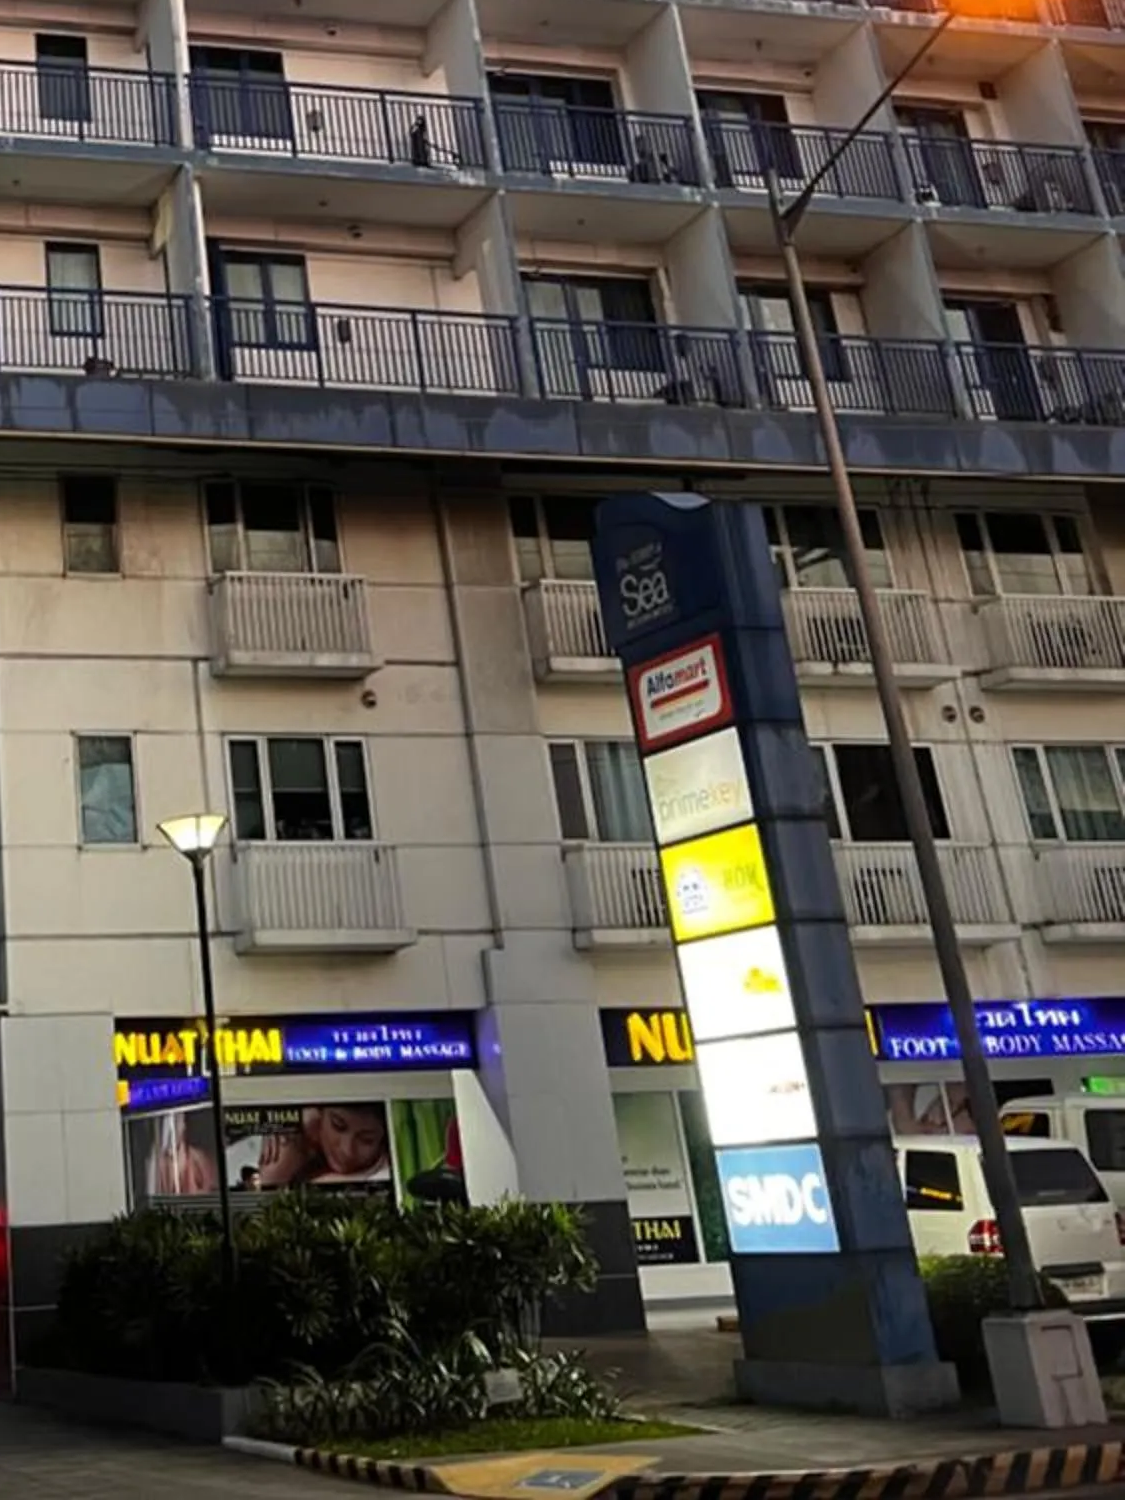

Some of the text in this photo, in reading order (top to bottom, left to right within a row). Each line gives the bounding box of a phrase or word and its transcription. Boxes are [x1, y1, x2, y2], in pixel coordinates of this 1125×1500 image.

[620, 571, 670, 616] Sea
[647, 656, 707, 696] Alfamart
[114, 1029, 197, 1066] NUAT
[400, 1042, 468, 1059] MASSAGE
[627, 1012, 695, 1062] NU
[891, 1031, 1125, 1058] FOOT BODY MASSA
[727, 1172, 826, 1225] SMDC
[632, 1220, 681, 1240] THAI
